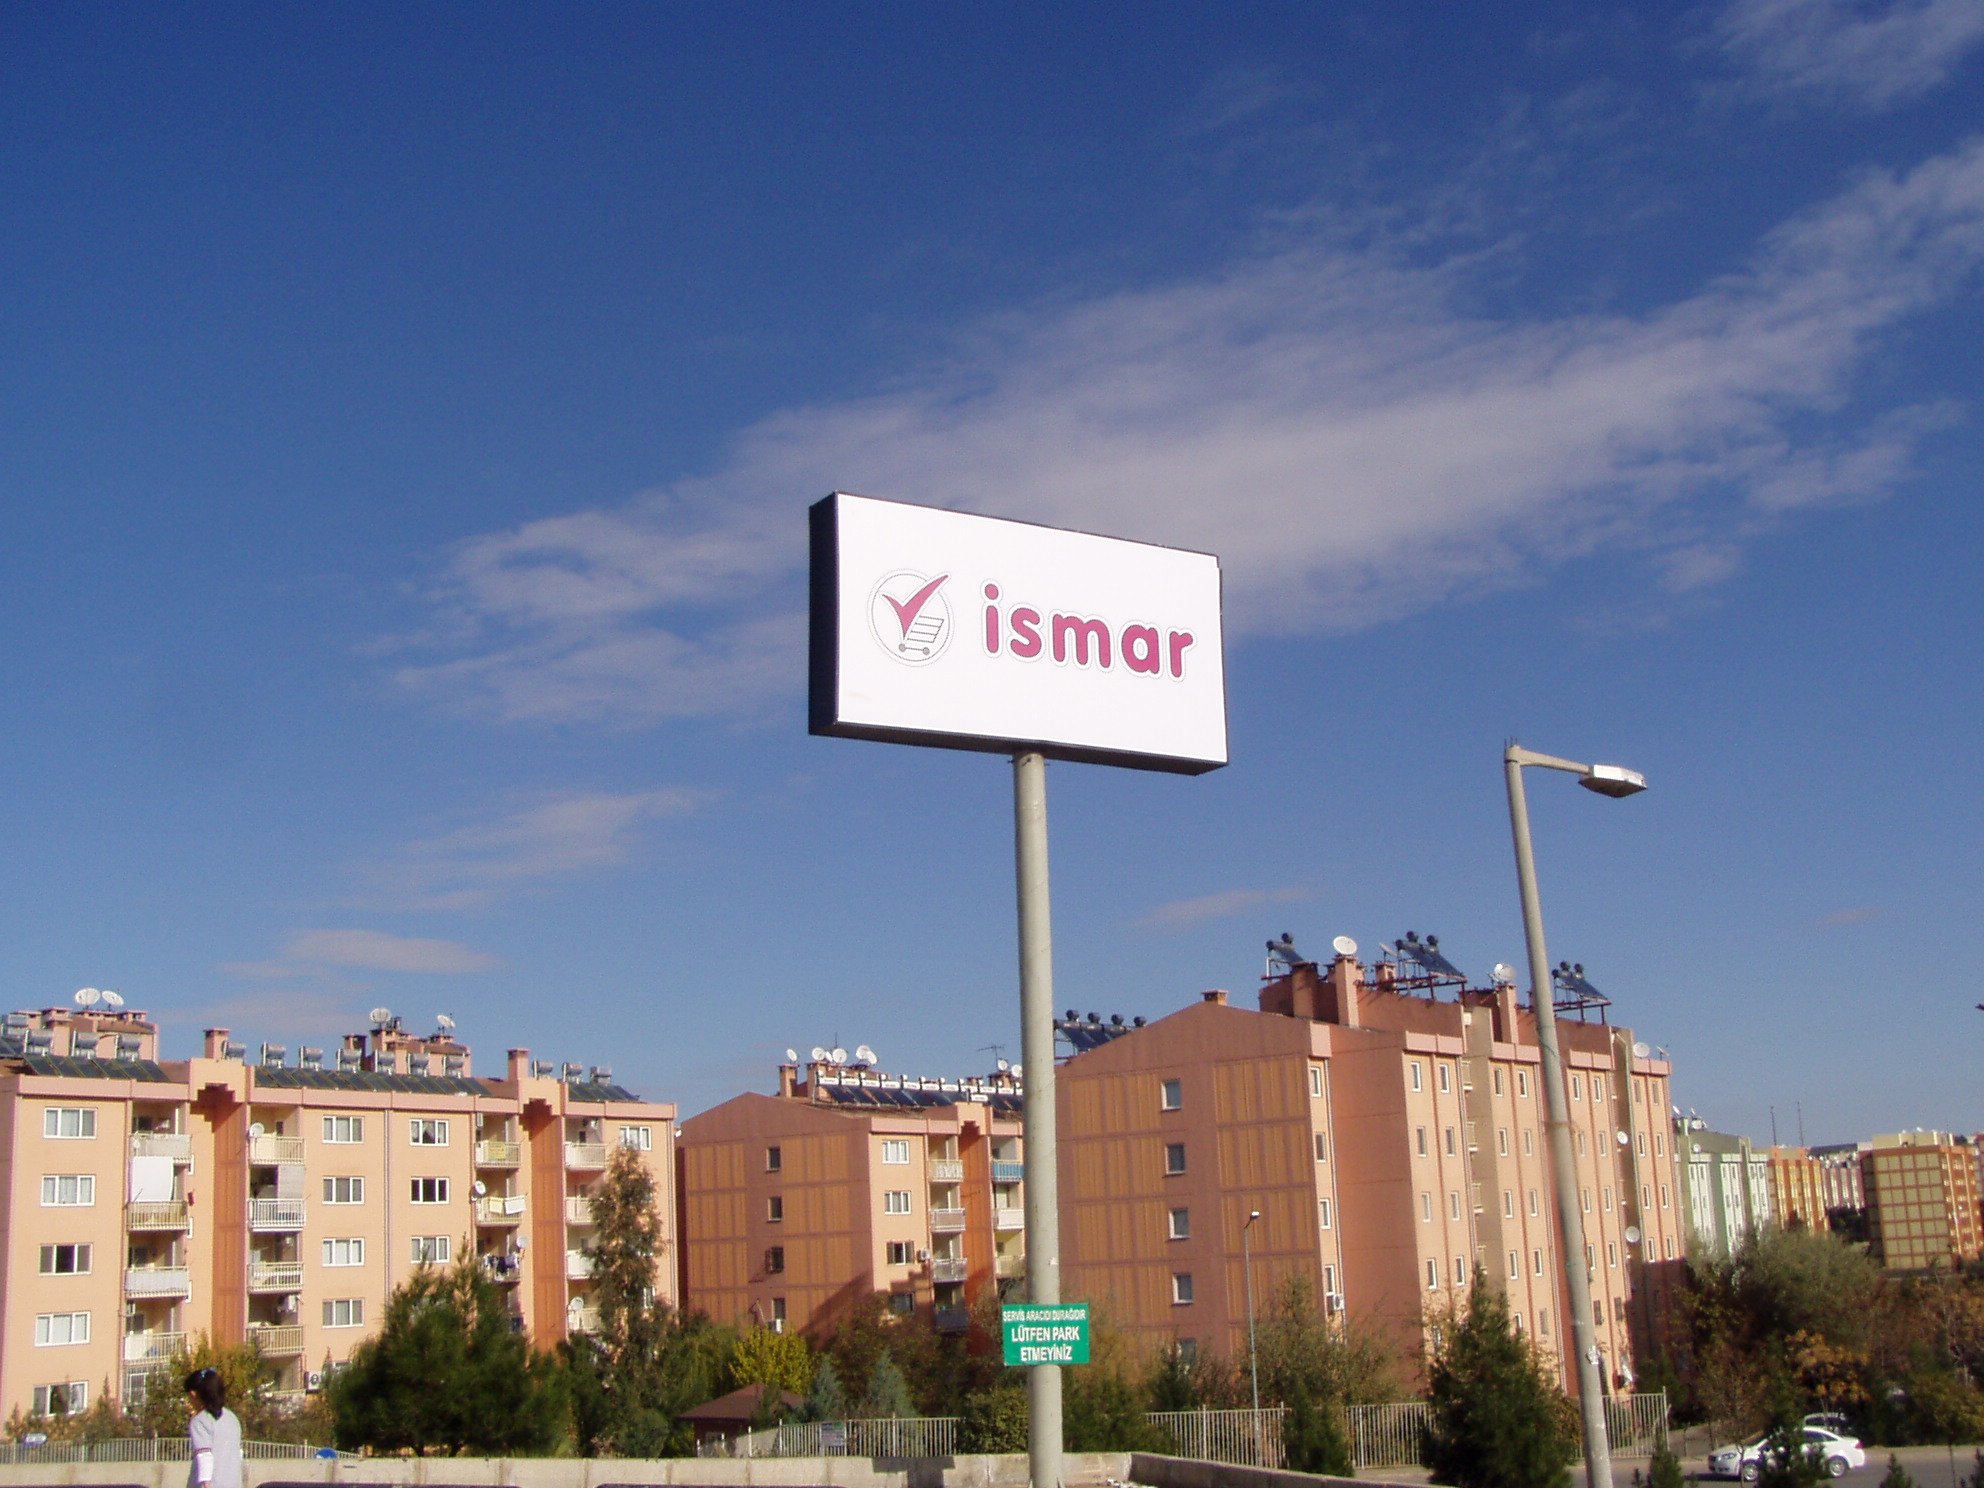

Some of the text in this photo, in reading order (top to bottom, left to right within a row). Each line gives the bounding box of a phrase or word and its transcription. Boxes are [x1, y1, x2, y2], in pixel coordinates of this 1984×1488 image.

[983, 583, 1193, 679] ismar
[1011, 1324, 1080, 1342] LÜTFEN PARK
[1020, 1343, 1073, 1361] ETMEYİNİZ
